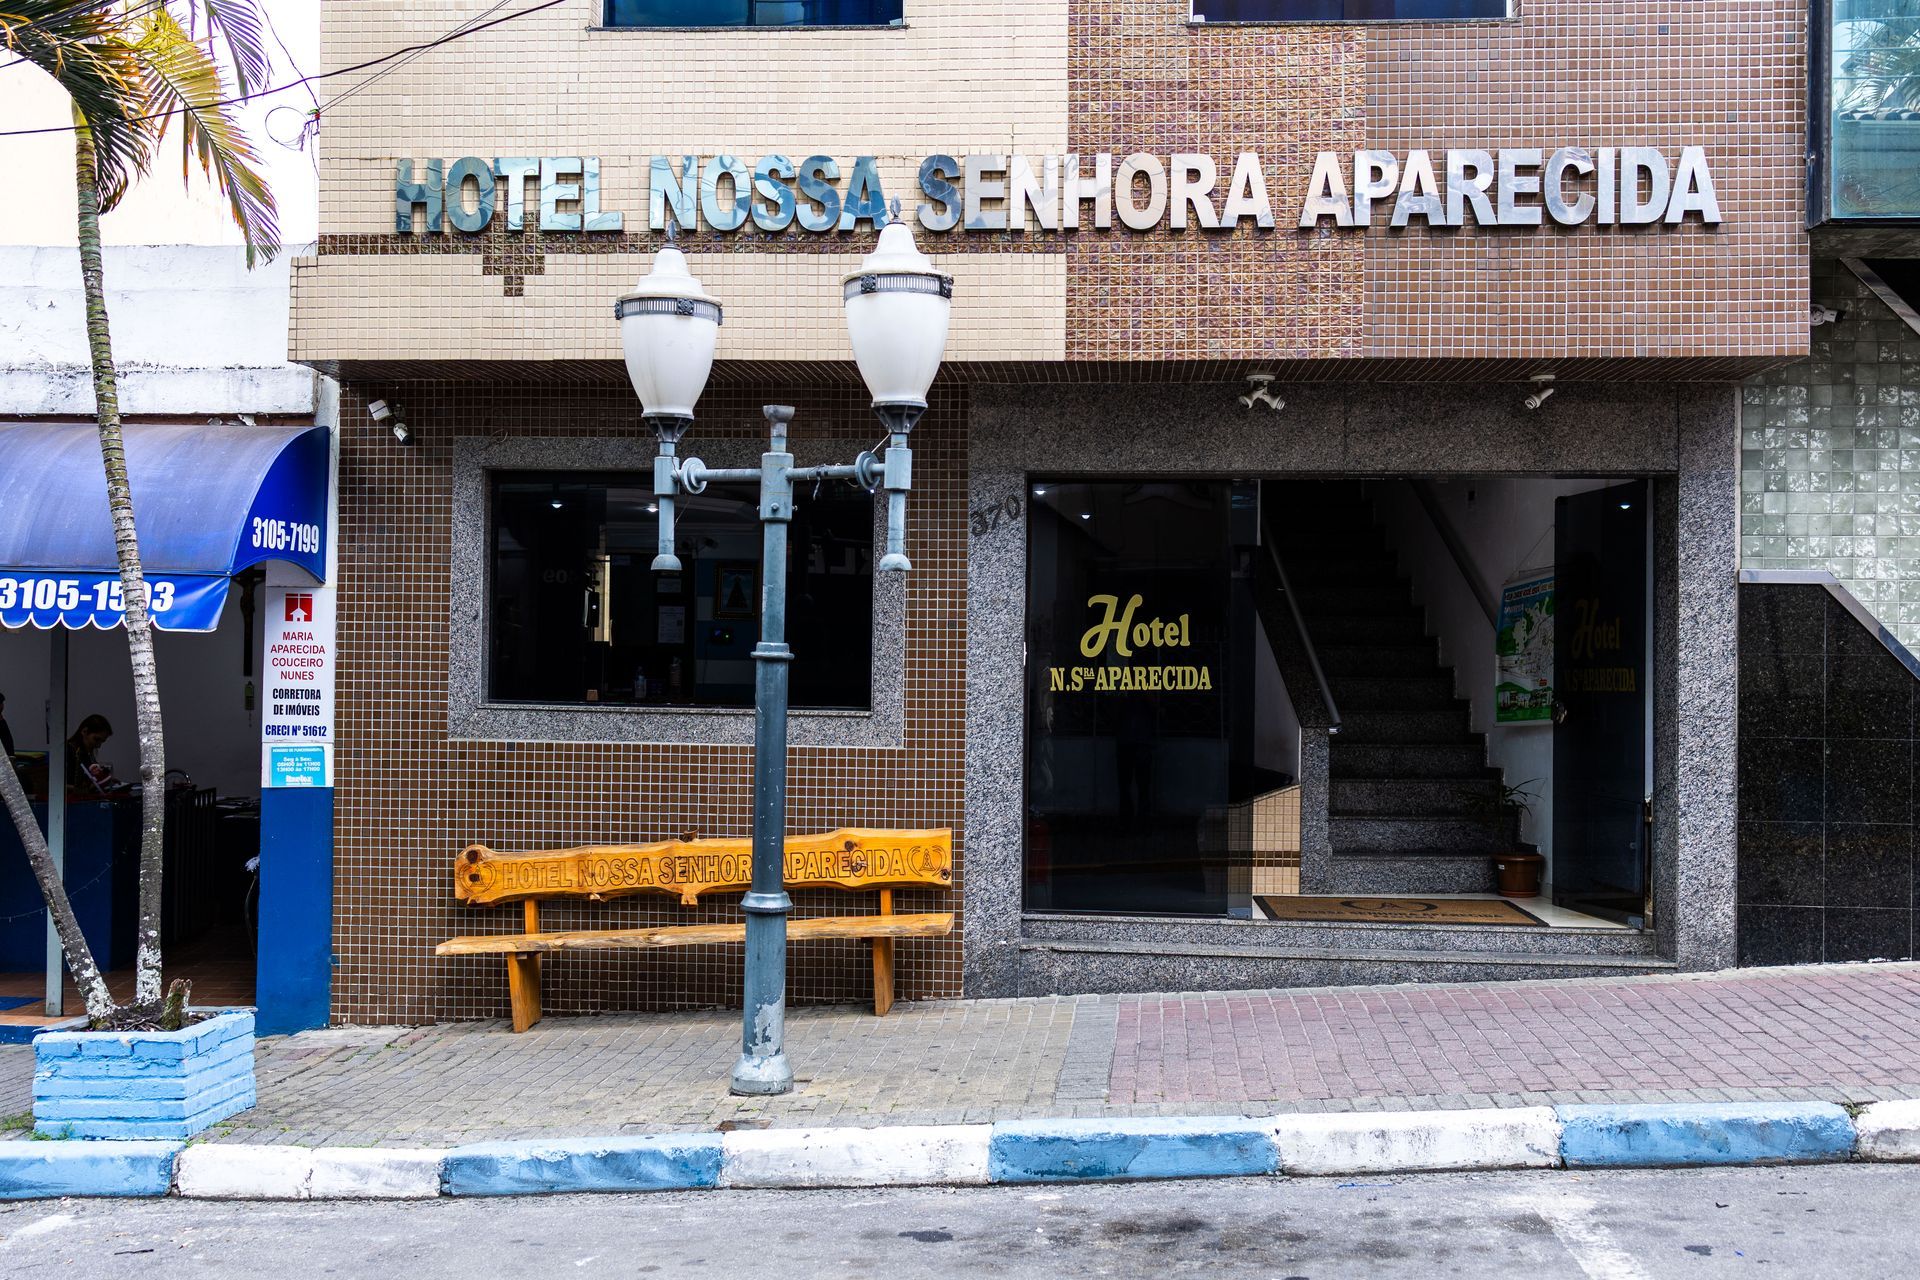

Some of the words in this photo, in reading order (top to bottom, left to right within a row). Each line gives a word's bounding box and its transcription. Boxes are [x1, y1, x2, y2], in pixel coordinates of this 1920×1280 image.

[395, 156, 624, 233] HOTEL
[649, 154, 890, 232] NOSSA
[917, 152, 1276, 232] SENHORA
[1300, 146, 1722, 228] APARECIDA
[970, 494, 1020, 538] 370
[252, 516, 320, 554] 3105-7199
[1080, 593, 1191, 658] Hotel
[282, 631, 314, 641] MARIA
[270, 644, 326, 654] APARECIDA
[271, 657, 324, 667] COUCEIRO
[280, 670, 315, 680] NUNES
[1094, 666, 1212, 691] APARECIDA
[272, 688, 321, 700] CORRETORA
[273, 704, 284, 715] DE
[285, 703, 320, 716] IMÓVEIS
[265, 724, 290, 736] CRECI
[302, 726, 327, 737] 51612
[502, 860, 573, 890] HOTEL
[577, 857, 655, 887] NOSSA
[658, 853, 753, 884] SENHOR
